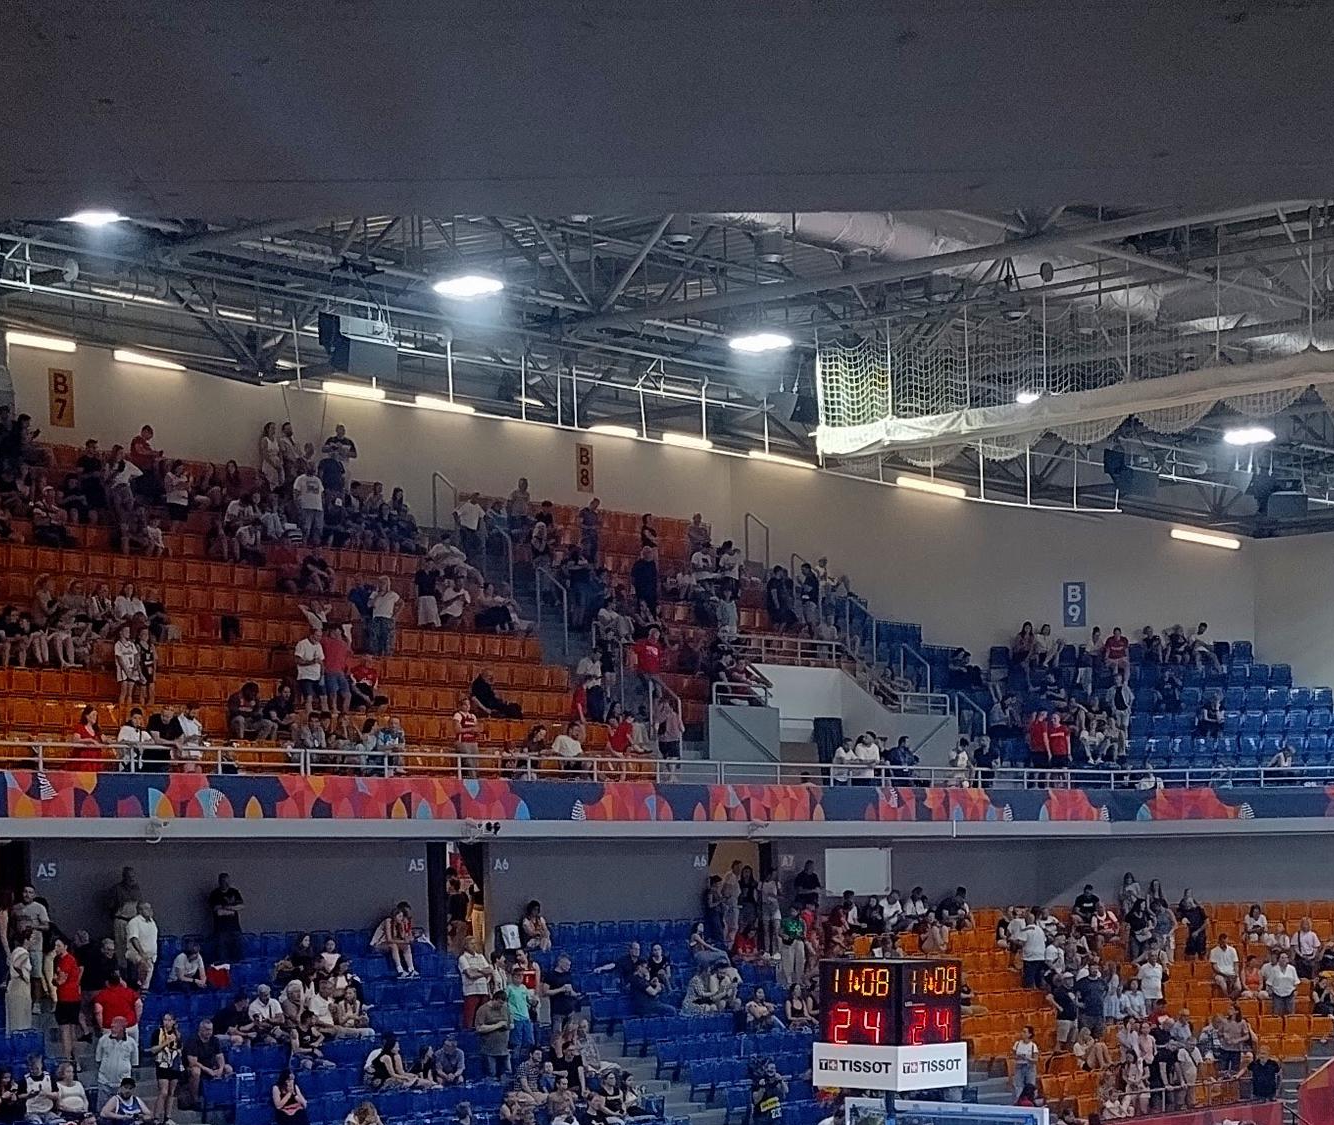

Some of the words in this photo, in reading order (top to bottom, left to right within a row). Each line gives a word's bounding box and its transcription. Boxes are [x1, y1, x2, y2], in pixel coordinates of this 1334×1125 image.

[53, 372, 68, 394] B
[54, 398, 68, 419] 7
[579, 447, 590, 466] B
[580, 468, 590, 487] 8
[1067, 585, 1081, 602] B
[1068, 604, 1081, 622] 9
[36, 862, 57, 878] A5
[409, 858, 425, 872] A5
[493, 858, 509, 871] A6
[833, 1008, 881, 1044] 24
[911, 1009, 951, 1045] 24
[839, 1060, 892, 1074] TISSOT
[920, 1059, 962, 1073] TISSOT
